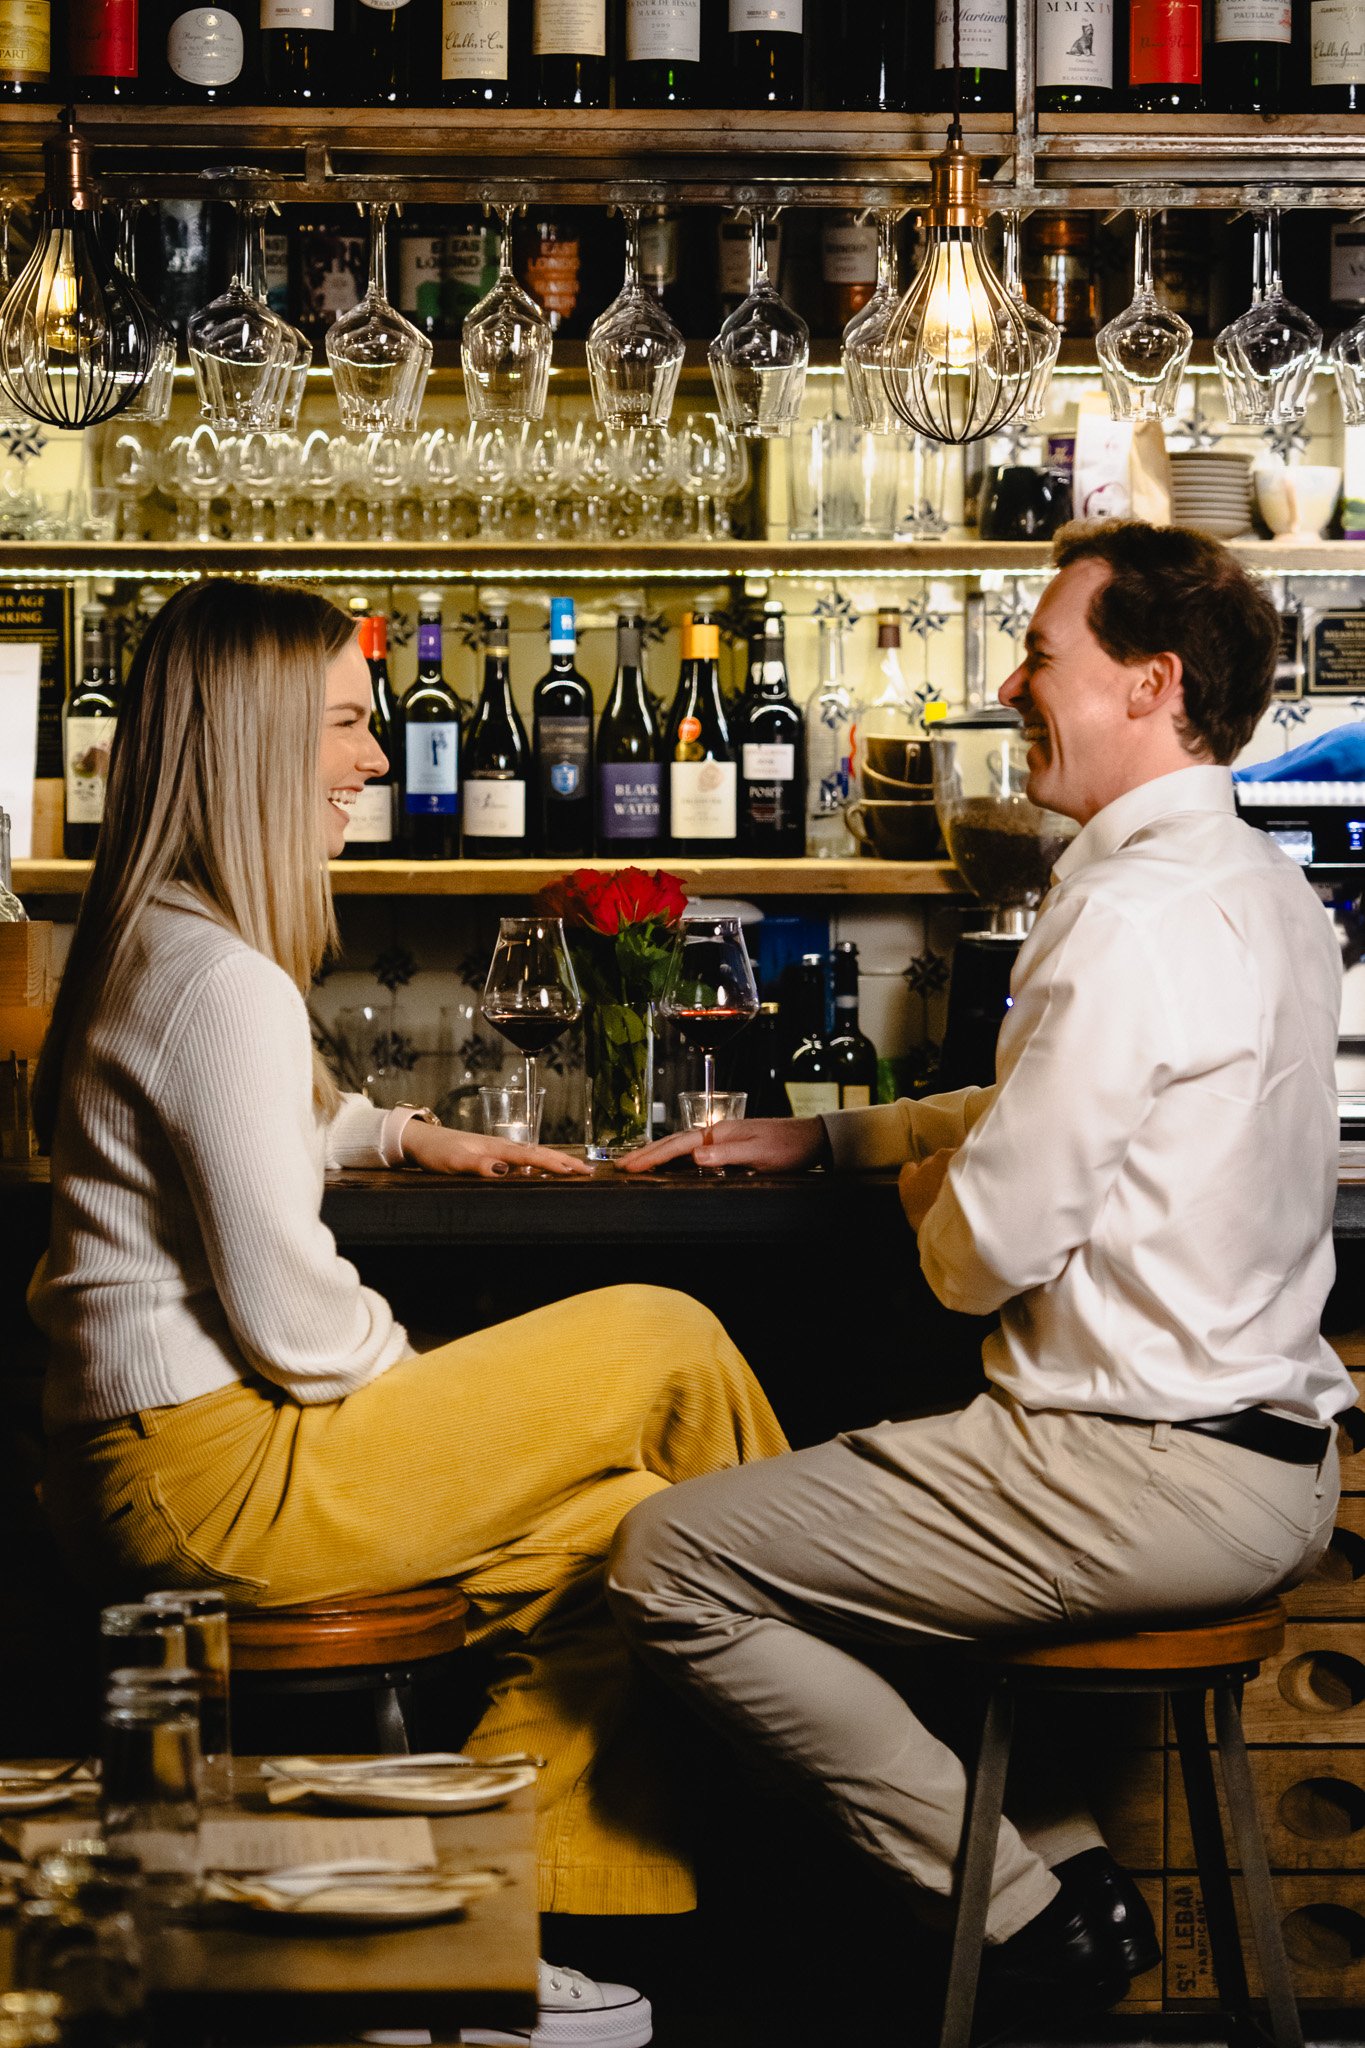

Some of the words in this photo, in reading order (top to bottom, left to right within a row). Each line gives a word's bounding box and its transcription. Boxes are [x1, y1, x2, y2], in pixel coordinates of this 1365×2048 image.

[445, 31, 478, 50] Chablis
[18, 594, 46, 608] AGE
[749, 786, 783, 798] PORT
[613, 802, 660, 816] WATER
